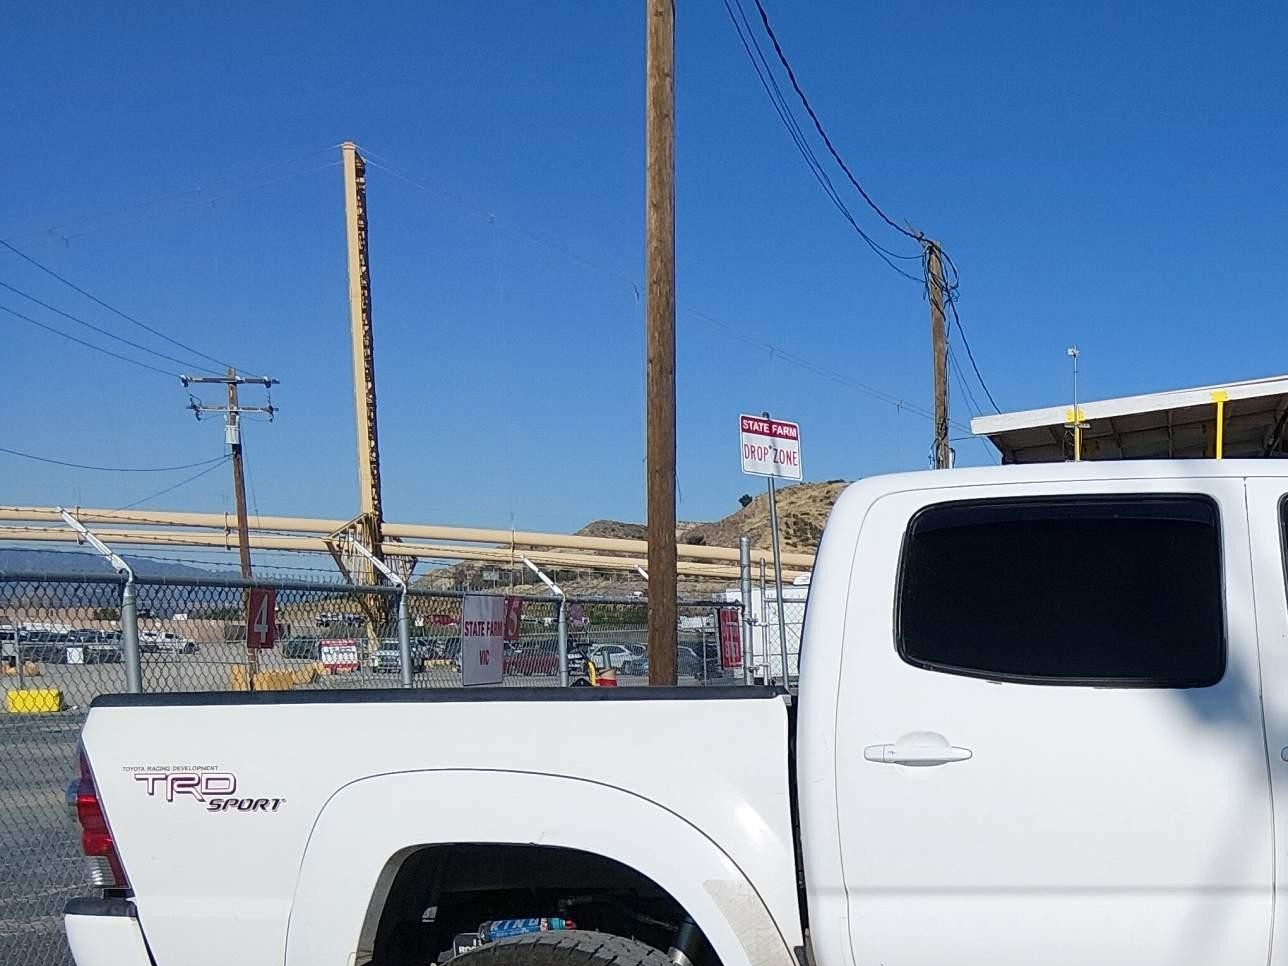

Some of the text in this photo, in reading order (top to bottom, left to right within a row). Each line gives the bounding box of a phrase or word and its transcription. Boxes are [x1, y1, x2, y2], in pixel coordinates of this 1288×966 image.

[743, 419, 797, 437] STATE FARM
[744, 443, 798, 466] DROP ZONE
[254, 593, 268, 643] 4
[464, 621, 503, 637] STATE FARM
[508, 600, 519, 637] 5
[134, 773, 237, 803] TRD
[207, 798, 284, 813] SPORT
